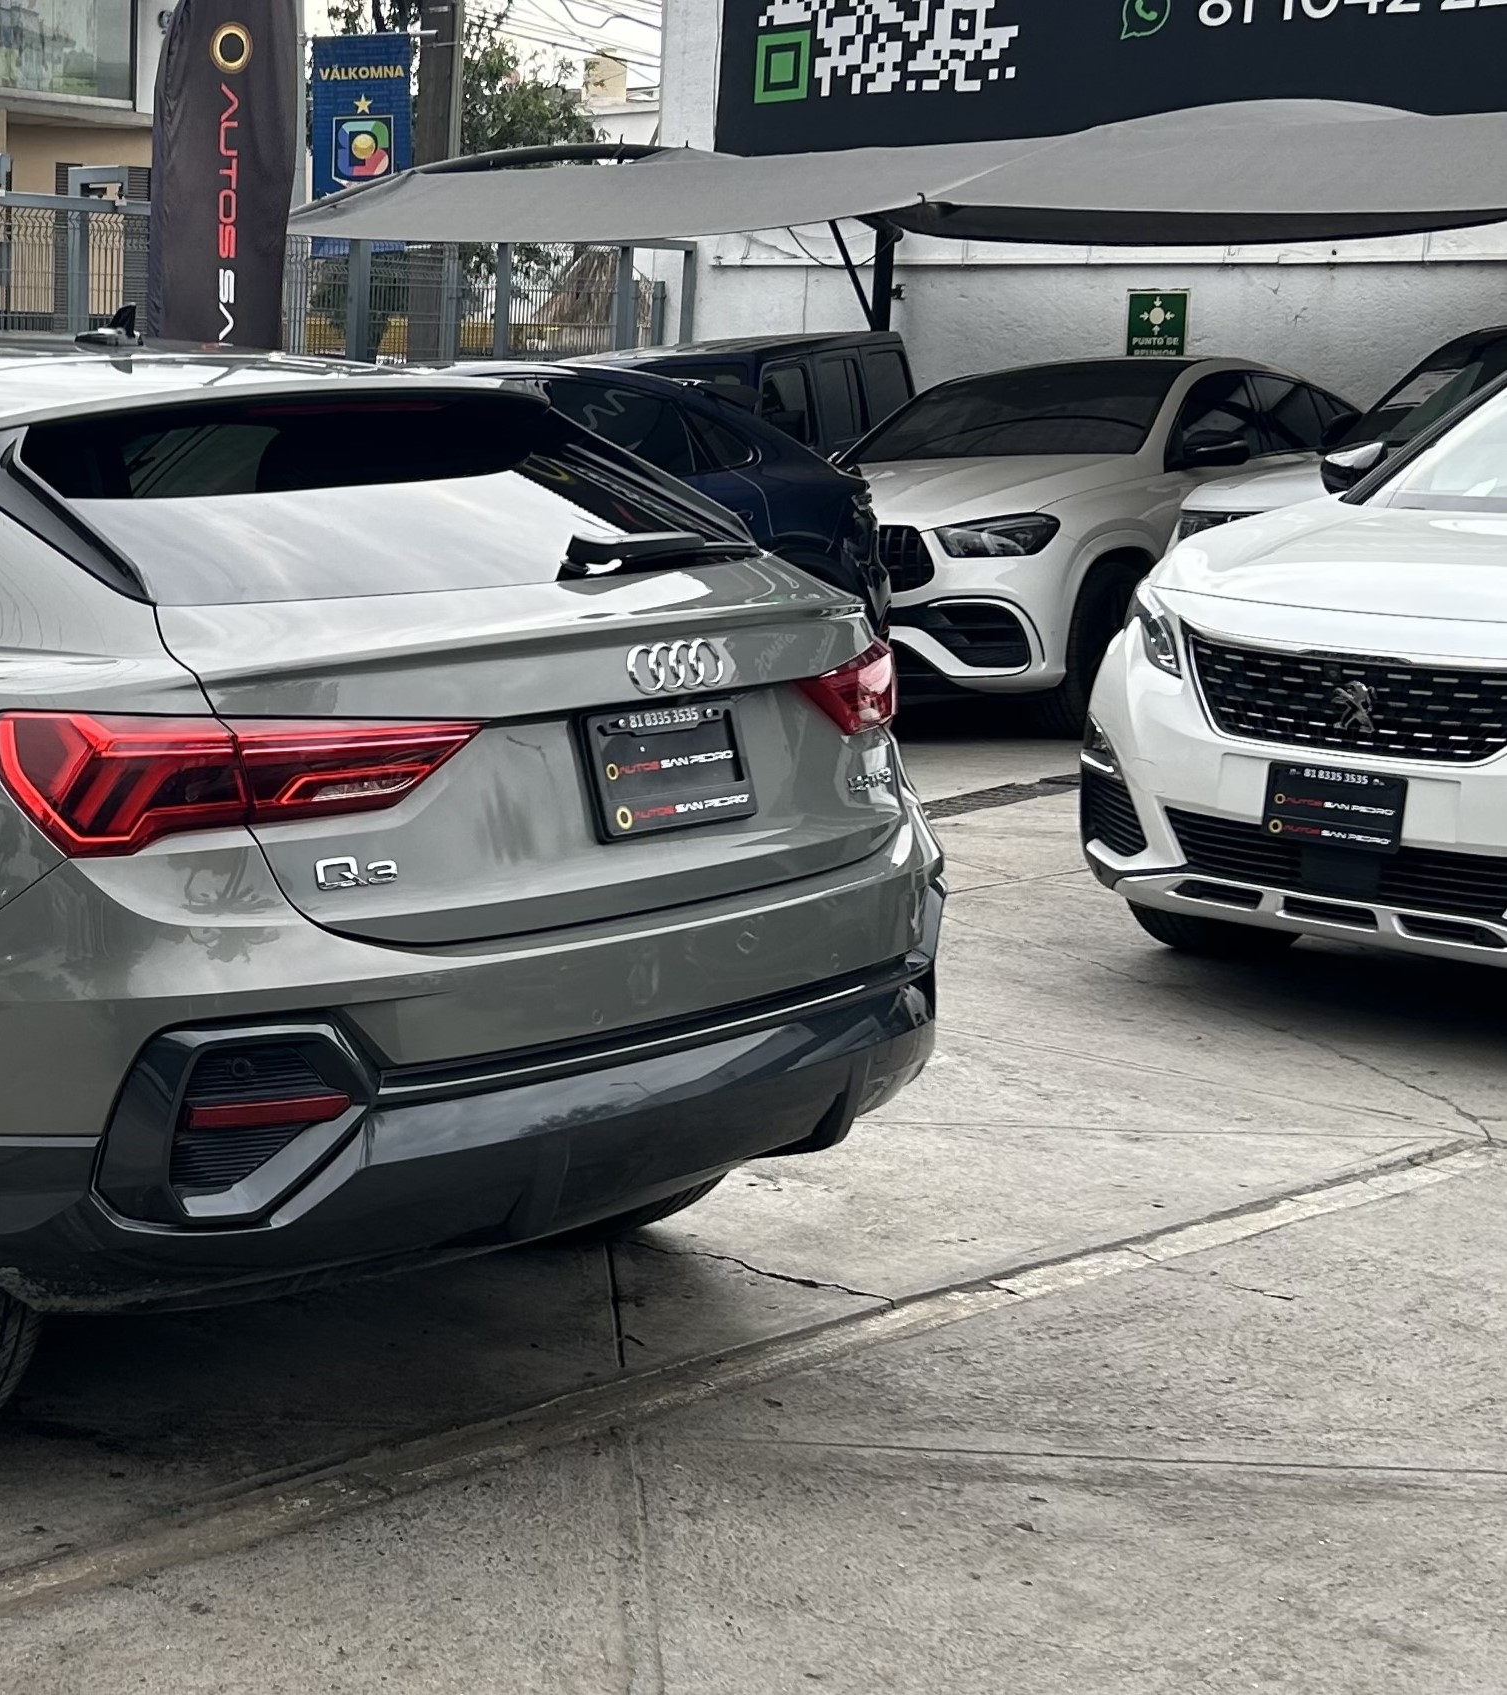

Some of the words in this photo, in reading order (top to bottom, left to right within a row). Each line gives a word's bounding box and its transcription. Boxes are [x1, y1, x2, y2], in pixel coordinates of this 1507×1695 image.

[319, 64, 405, 81] VÄLKOMNA
[218, 82, 239, 259] AUTOS
[219, 268, 235, 346] SA
[1132, 336, 1164, 346] PUNTO
[1166, 337, 1179, 345] DE
[629, 715, 643, 729] 81
[645, 711, 671, 726] 8335
[673, 707, 699, 722] 3535
[619, 760, 661, 775] AUTOS
[660, 756, 689, 769] SAN
[689, 750, 734, 764] PEDRO
[1304, 768, 1316, 778] 81
[1318, 770, 1342, 782] 8335
[1344, 773, 1369, 785] 3535
[633, 805, 675, 820] AUTOS
[675, 801, 704, 813] SAN
[704, 794, 749, 808] PEDRO
[1323, 801, 1350, 811] SAN
[1351, 804, 1395, 816] PEDRO
[1321, 829, 1346, 839] SAN
[1348, 834, 1391, 845] PEDRO
[315, 856, 398, 890] Q3
